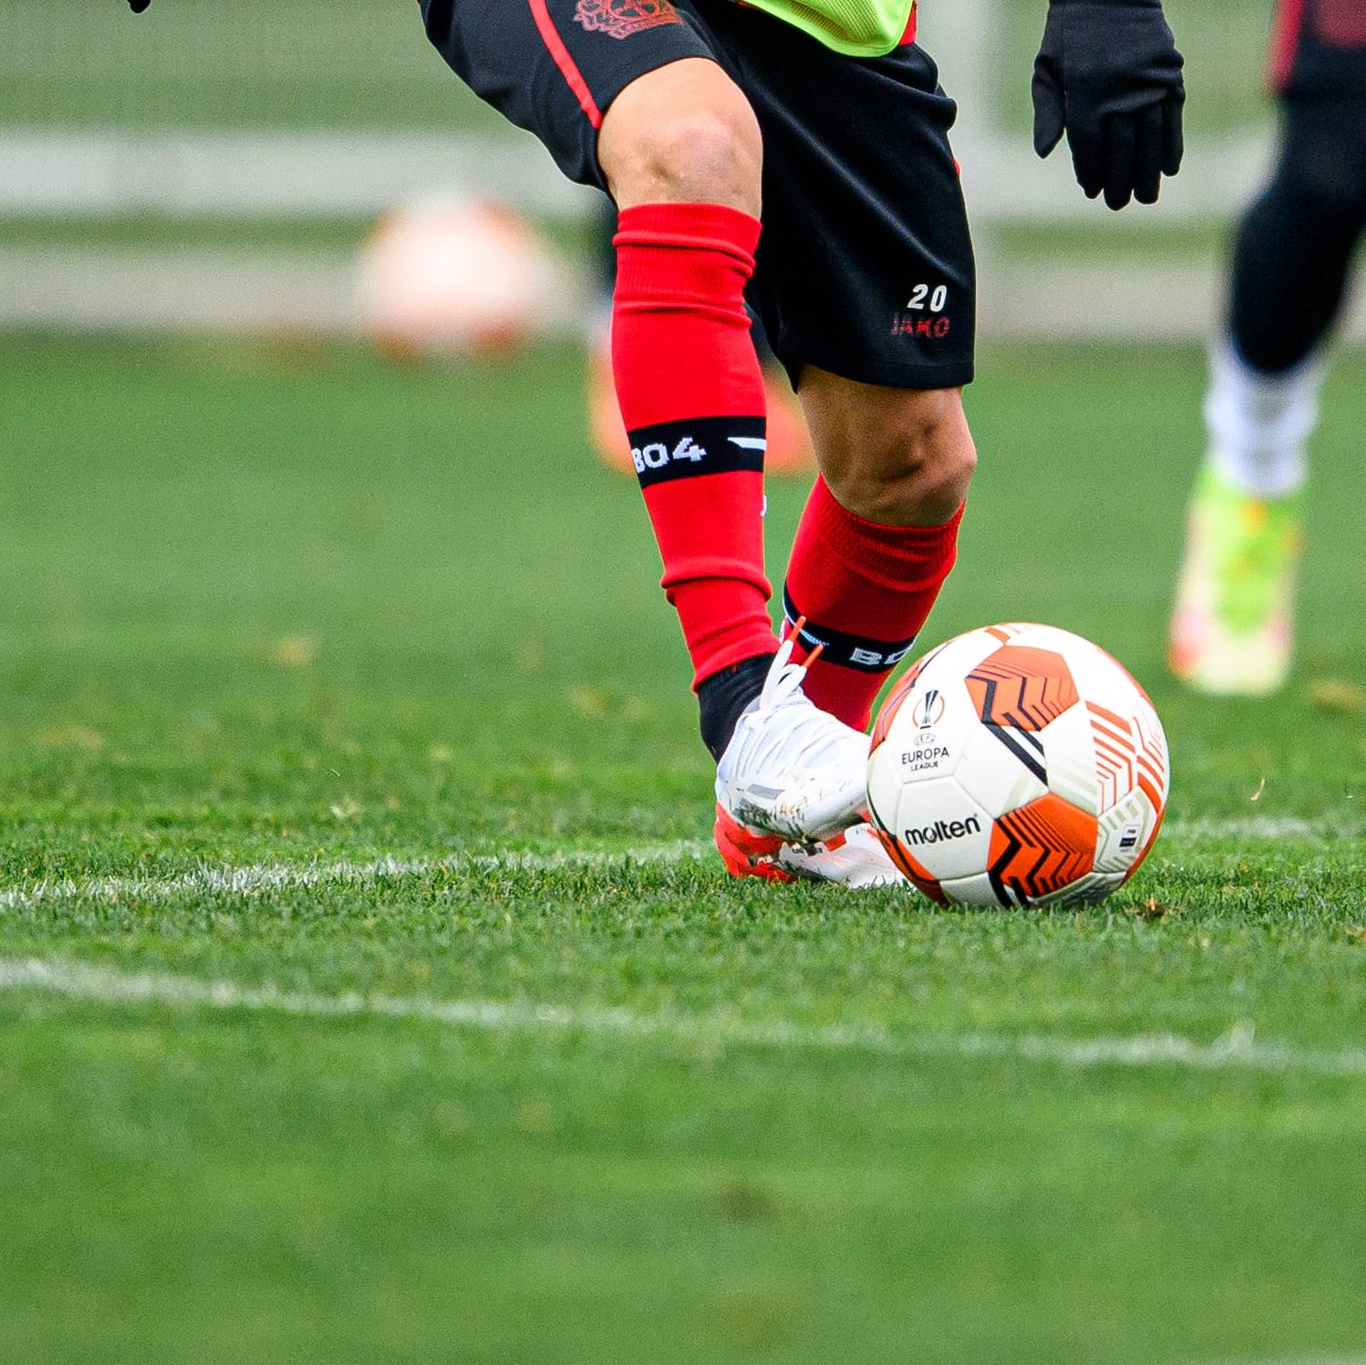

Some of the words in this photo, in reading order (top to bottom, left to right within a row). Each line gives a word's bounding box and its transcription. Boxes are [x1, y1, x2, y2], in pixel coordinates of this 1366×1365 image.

[906, 283, 948, 313] 20
[891, 315, 951, 338] JAKO
[901, 746, 950, 765] EUROPA
[910, 760, 939, 772] LEAGUE
[904, 816, 981, 846] molten
